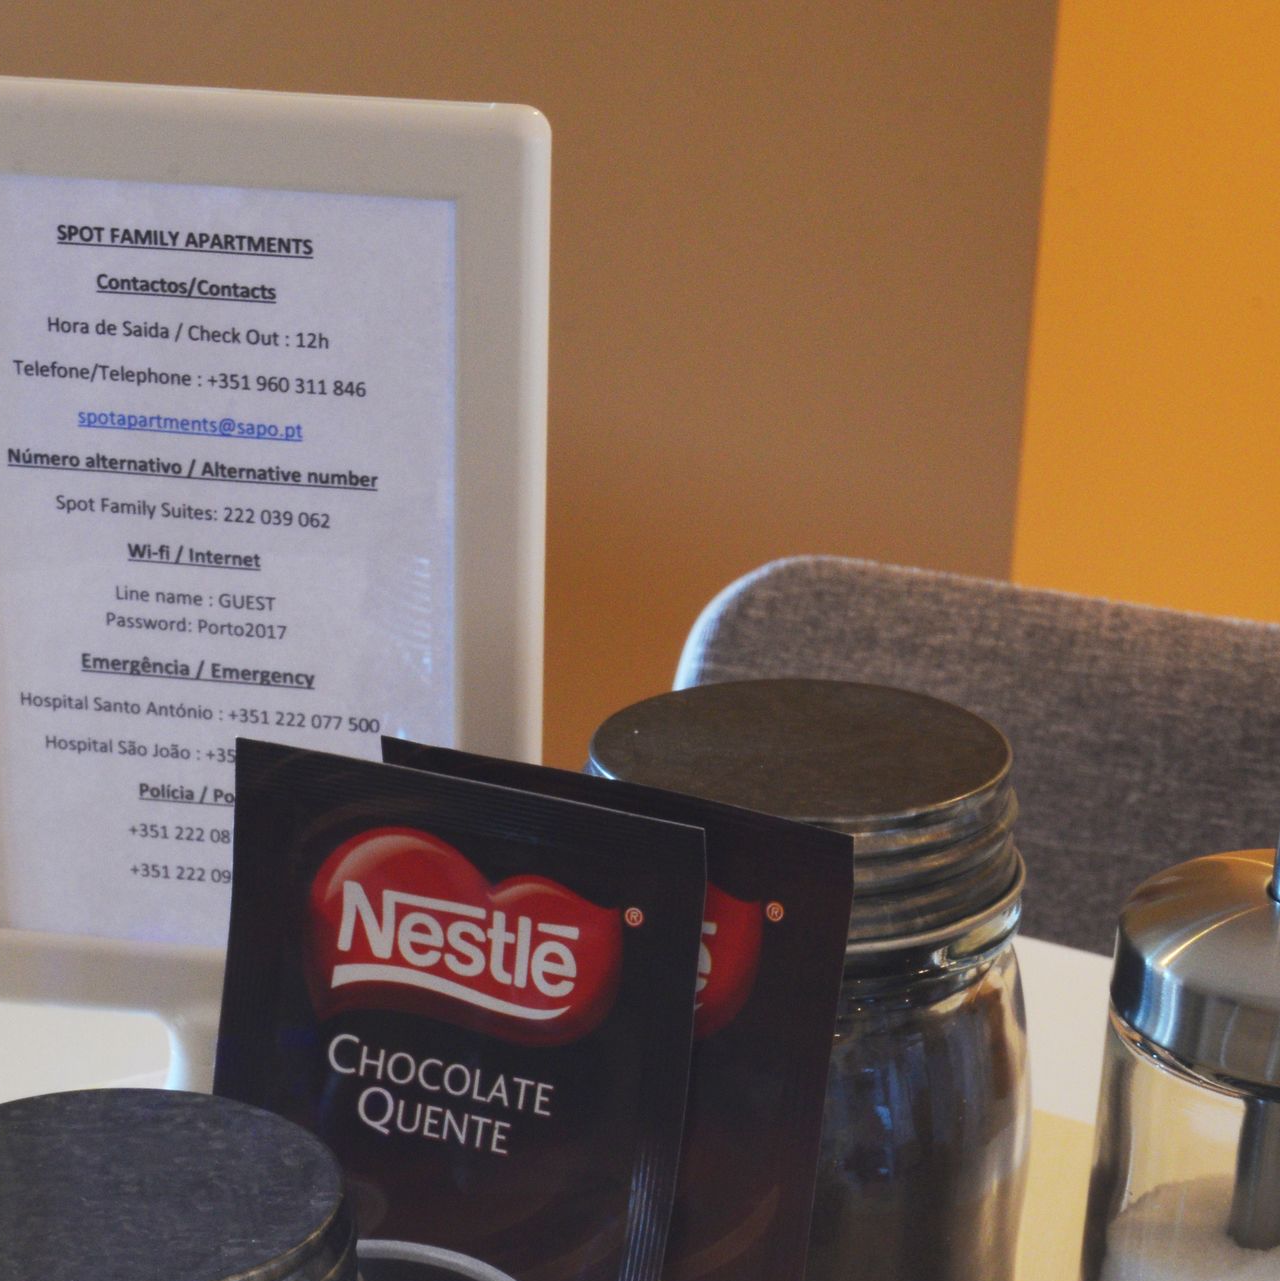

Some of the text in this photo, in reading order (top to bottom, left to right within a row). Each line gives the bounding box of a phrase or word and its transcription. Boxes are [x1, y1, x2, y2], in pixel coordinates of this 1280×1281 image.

[56, 224, 314, 257] SPOT FAMILY APARTMENTS
[95, 273, 277, 303] Contactos/Contacts
[47, 316, 90, 335] Hora
[95, 319, 117, 336] de
[122, 320, 170, 340] Saida
[188, 325, 241, 345] Check
[246, 329, 280, 348] Out
[296, 332, 330, 350] 12h
[12, 360, 192, 388] Telefone/Telephone
[207, 373, 251, 393] +351
[256, 376, 291, 394] 960
[295, 378, 328, 396] 311
[332, 380, 367, 398] 846
[78, 411, 304, 442] spotapartments@sapo.pt
[7, 448, 81, 468] Número
[85, 453, 183, 476] alternativo
[201, 461, 302, 483] Alternative
[307, 470, 379, 489] number
[56, 494, 331, 529] Spot Family Suites: 222 039 062
[127, 542, 171, 561] Wi-fi
[188, 548, 261, 569] Internet
[115, 585, 150, 602] Line
[155, 591, 203, 607] name
[218, 593, 277, 612] GUEST
[106, 612, 287, 640] Password: Porto2017
[81, 652, 190, 677] Emergência
[211, 662, 316, 689] Emergency
[20, 691, 89, 712] Hospital
[93, 696, 141, 715] Santo
[146, 698, 213, 721] António
[228, 708, 270, 725] +351
[275, 711, 306, 728] 222
[310, 713, 344, 731] 077
[348, 716, 381, 734] 500
[45, 734, 113, 755] Hospital
[118, 740, 148, 757] São
[152, 743, 191, 761] João
[139, 782, 195, 801] Polícia
[128, 823, 169, 840] +351
[175, 825, 205, 843] 222
[130, 863, 170, 880] +351
[176, 866, 206, 883] 222
[337, 880, 580, 998] Nestlé
[328, 1033, 554, 1117] CHOCOLATE
[357, 1086, 511, 1155] QUENTE
